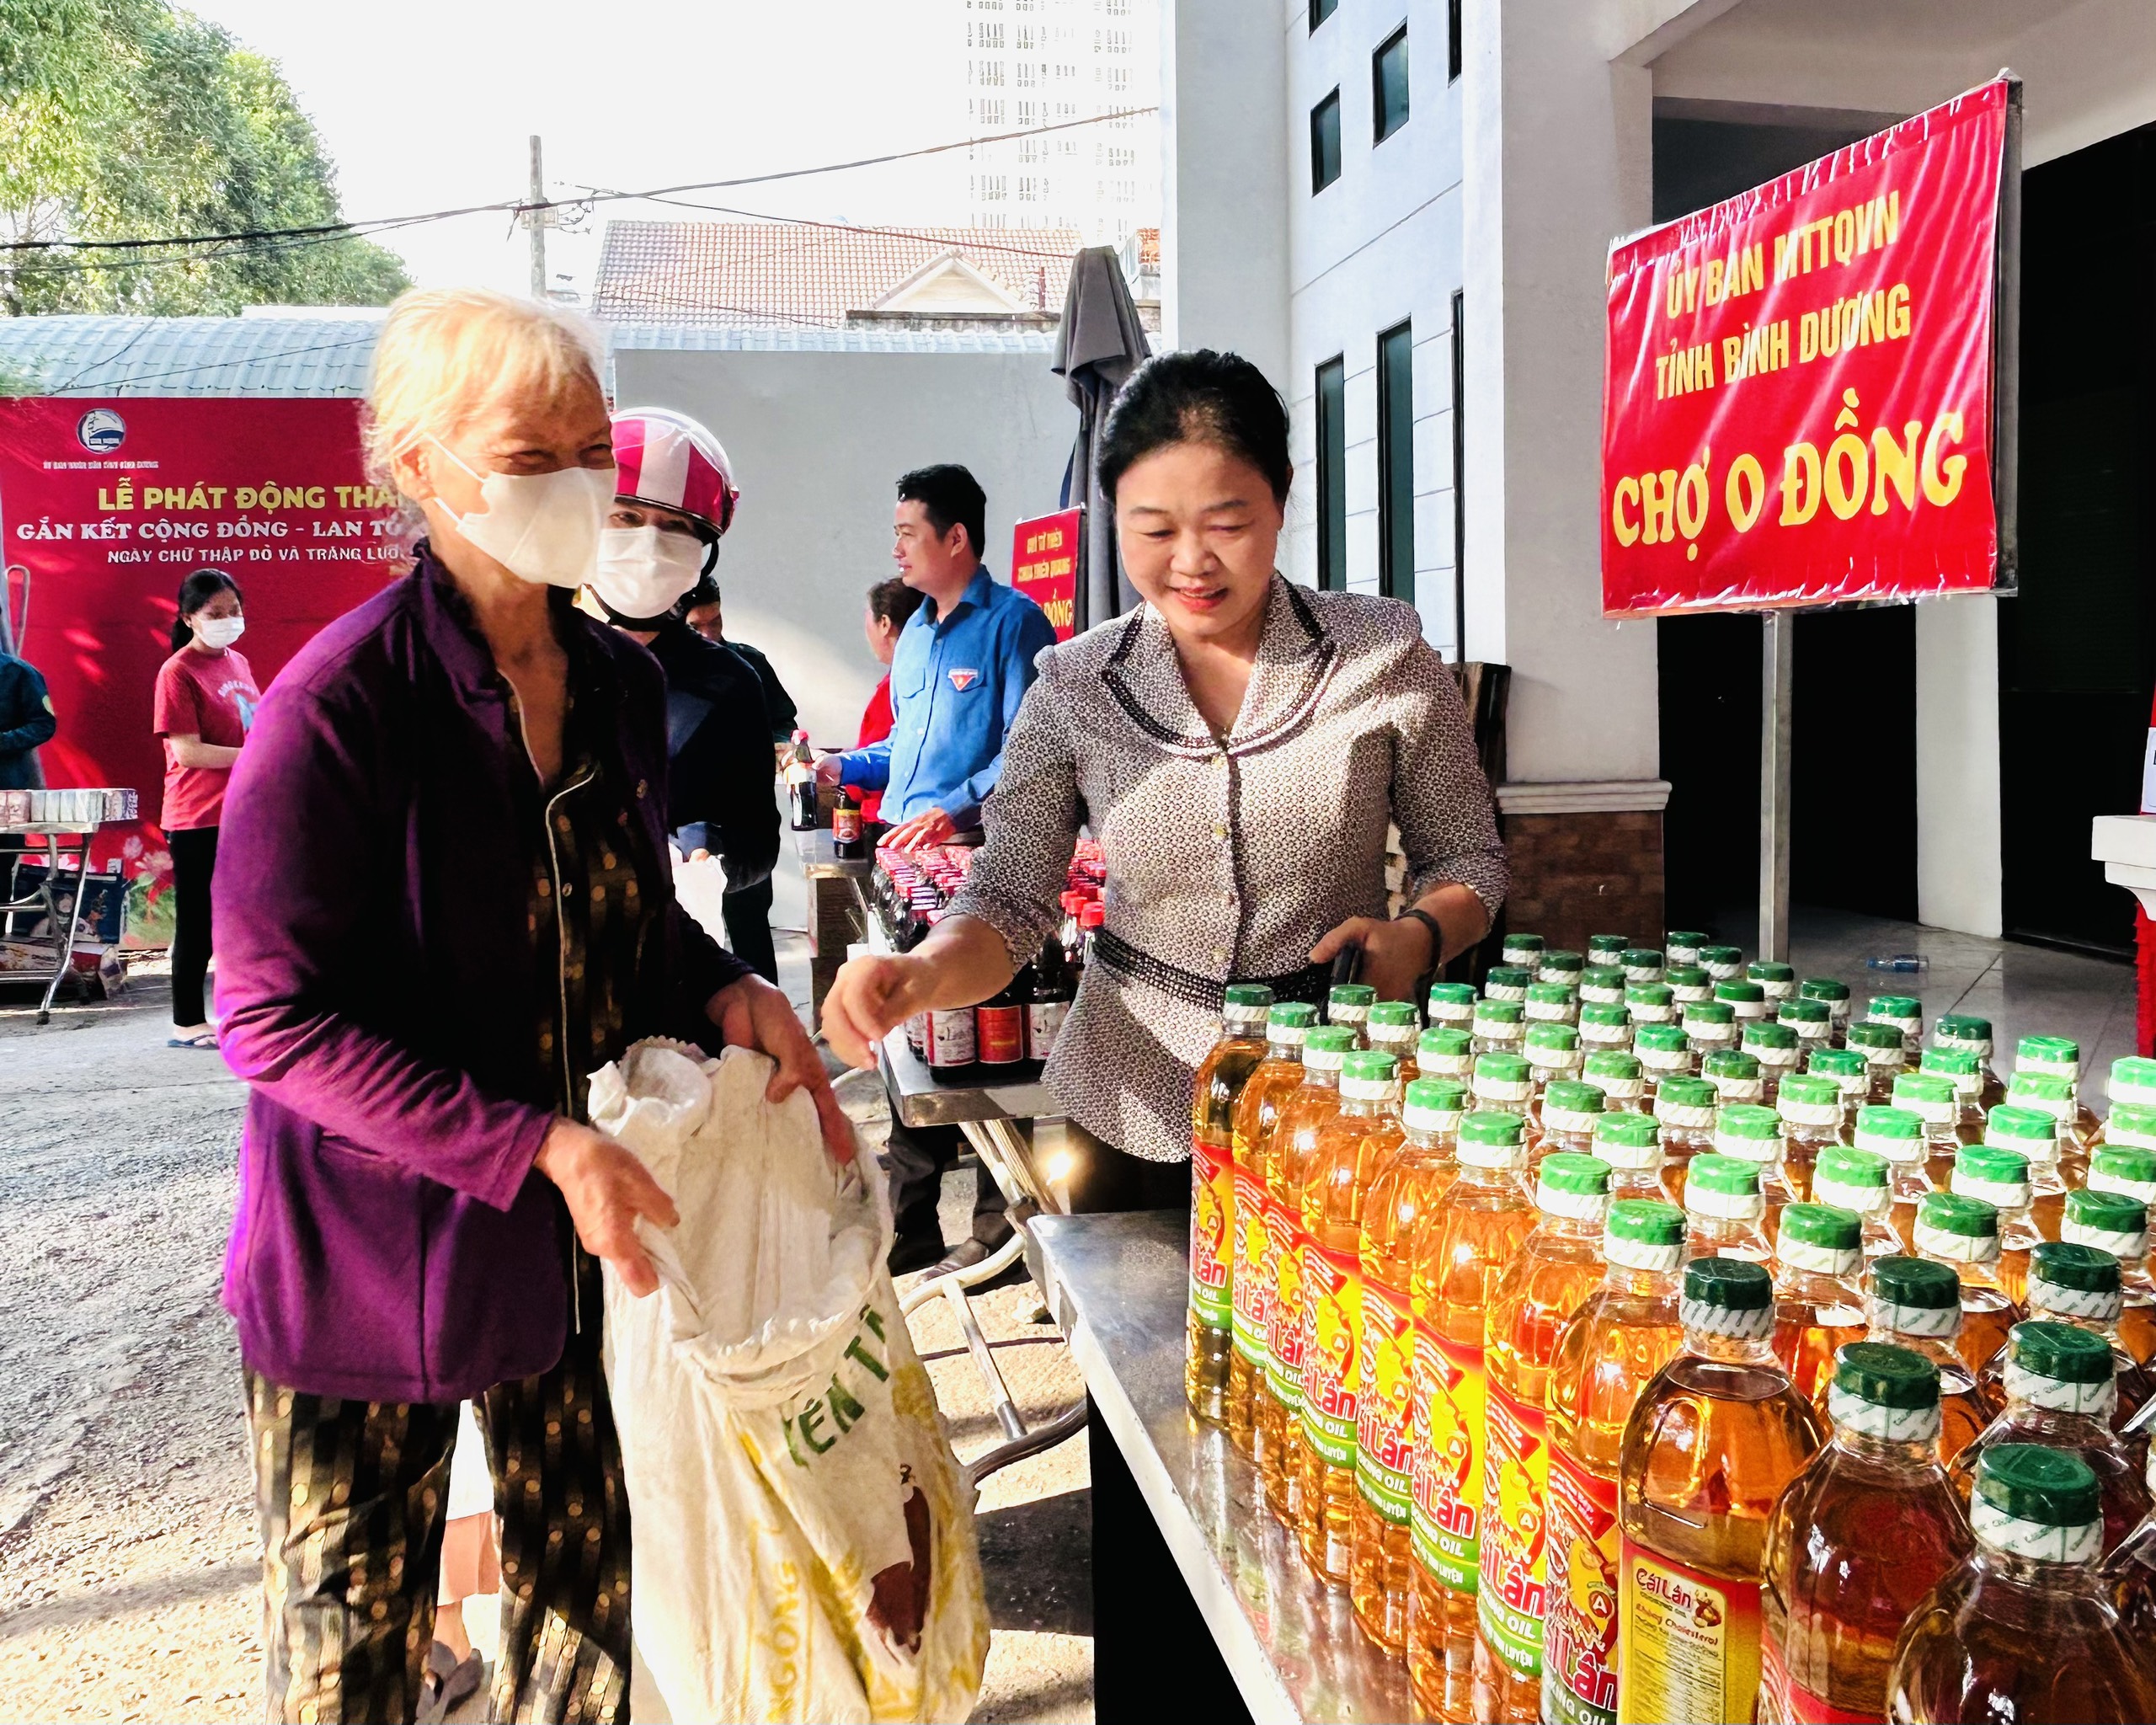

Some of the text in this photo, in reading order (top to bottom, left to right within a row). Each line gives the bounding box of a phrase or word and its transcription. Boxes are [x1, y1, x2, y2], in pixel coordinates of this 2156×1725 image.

[1705, 243, 1764, 307] BAN
[1774, 190, 1900, 286] MTTQVN
[1655, 283, 1911, 401] TỈNH BÌNH DƯƠNG
[1613, 446, 1710, 561] CHỢ
[1780, 387, 1967, 526] ĐỒNG
[99, 477, 134, 510] LỄ
[144, 481, 228, 510] PHÁT
[234, 481, 326, 515] ĐỘNG
[81, 516, 132, 539] KẾT
[138, 518, 210, 543] CỘNG
[312, 521, 362, 537] LAN
[107, 547, 152, 563] NGÀY
[199, 547, 244, 563] THẬP
[278, 546, 300, 560] VÀ
[1325, 1419, 1348, 1439] OIL
[1384, 1475, 1408, 1494] OIL
[1439, 1536, 1465, 1557] OIL
[1507, 1616, 1536, 1639] OIL
